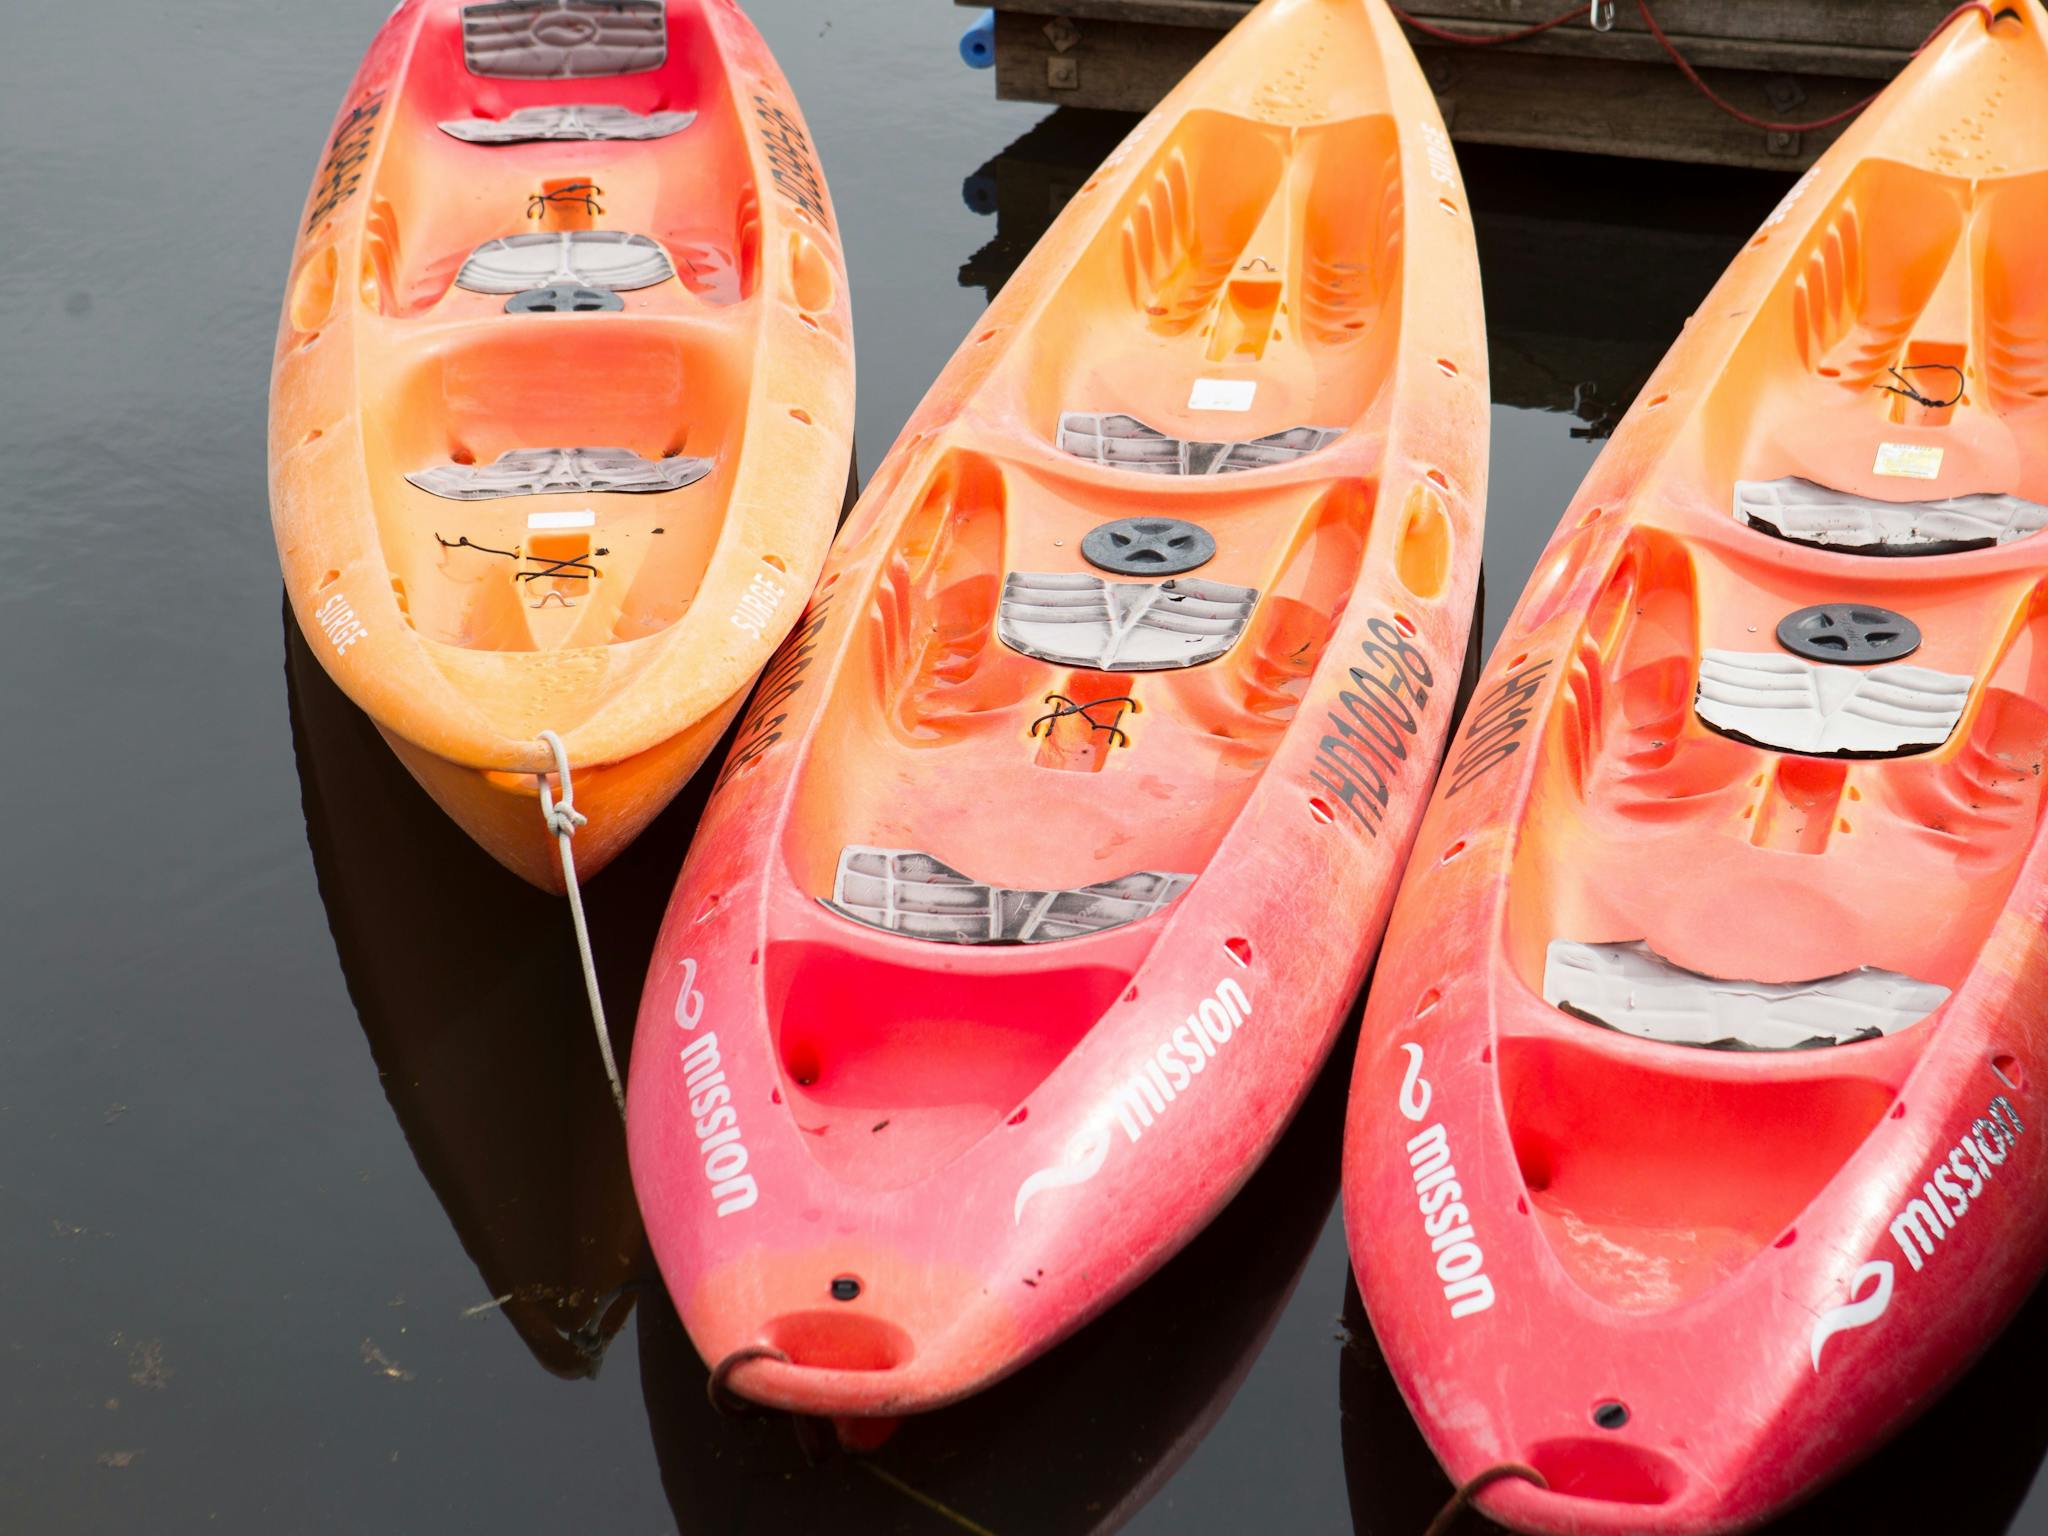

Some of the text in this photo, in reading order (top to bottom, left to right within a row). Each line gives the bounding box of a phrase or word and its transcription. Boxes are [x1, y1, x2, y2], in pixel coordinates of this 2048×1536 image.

[315, 593, 368, 656] SURGE
[729, 572, 785, 640] SURGE
[1310, 617, 1433, 838] HD100-28
[1445, 658, 1553, 799] HD100
[680, 1031, 759, 1217] mission
[1113, 978, 1252, 1143] mission
[1406, 1122, 1495, 1319] mission
[1889, 1095, 2024, 1272] mission
